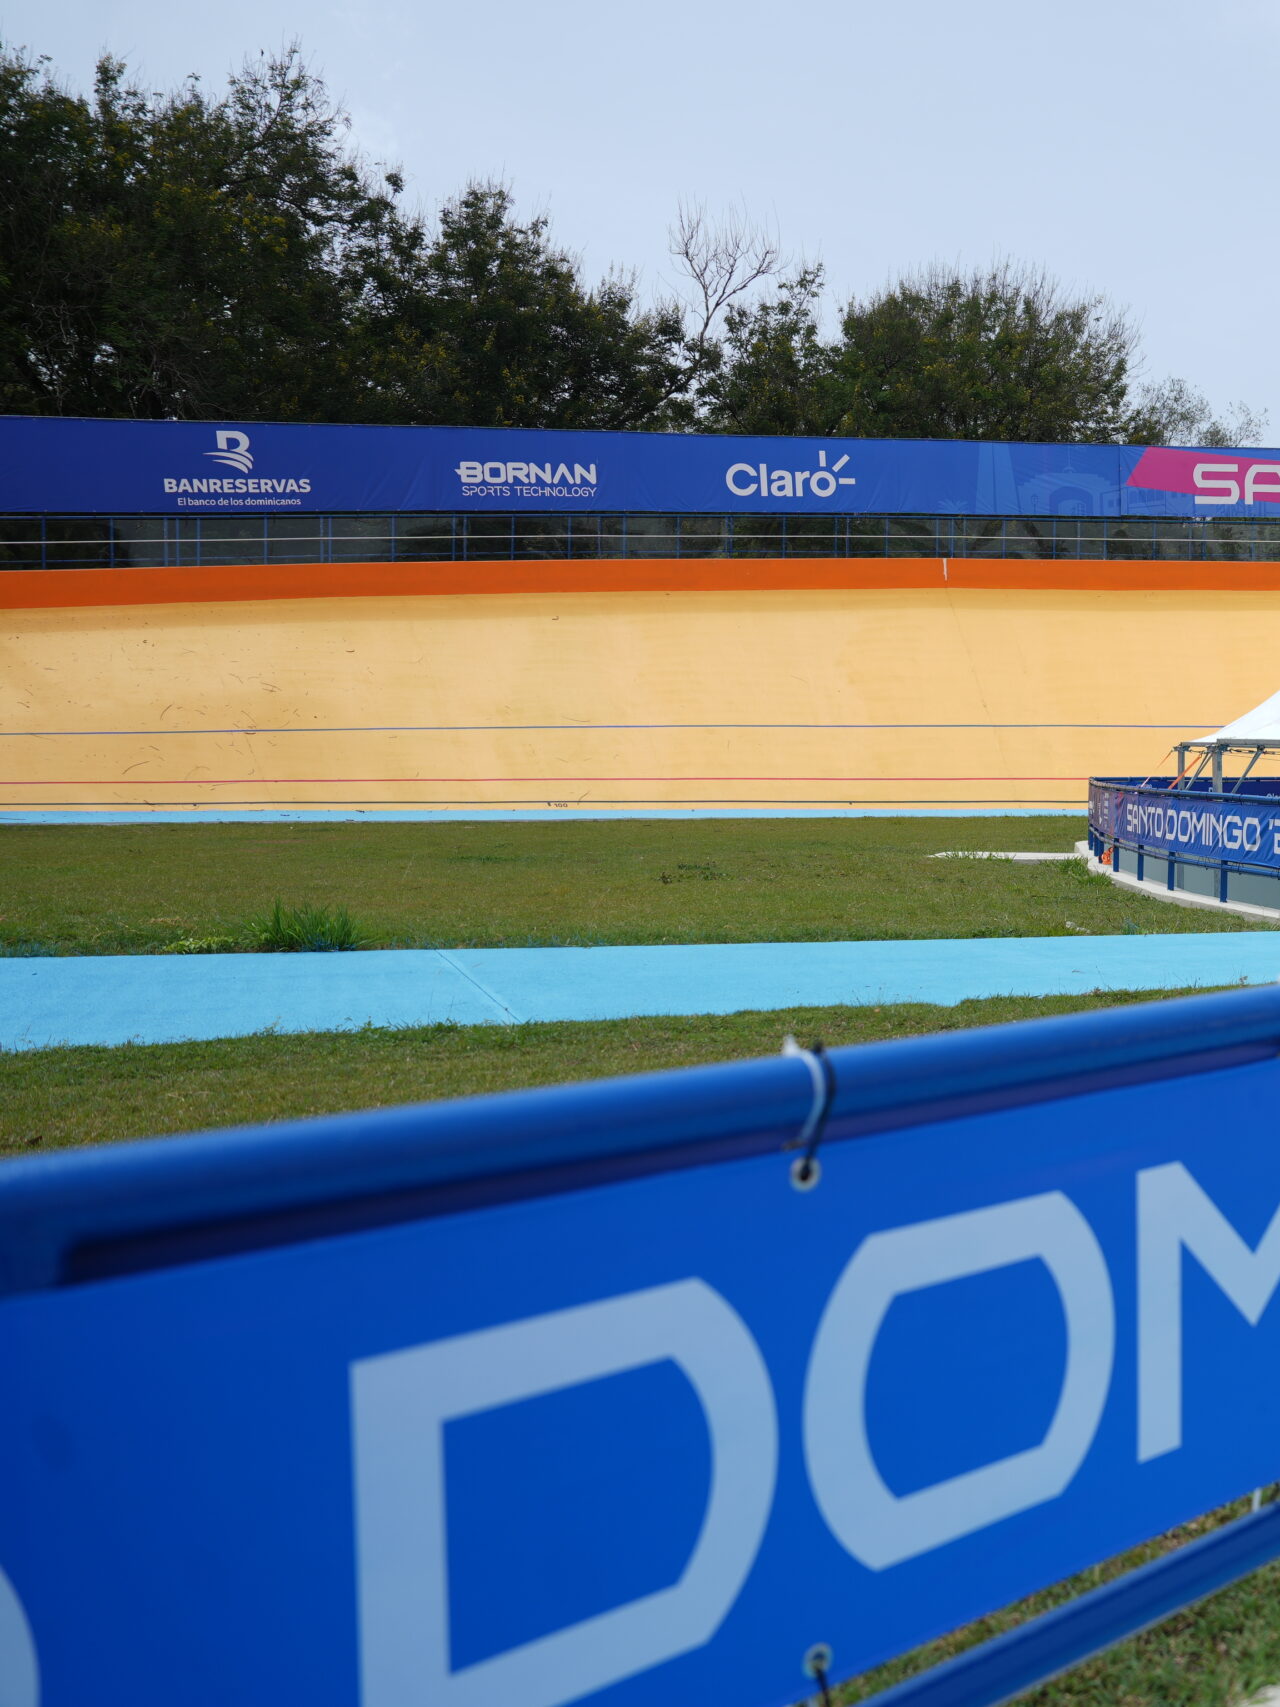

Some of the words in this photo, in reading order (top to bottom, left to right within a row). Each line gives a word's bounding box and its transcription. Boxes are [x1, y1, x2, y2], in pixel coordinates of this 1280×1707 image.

[455, 461, 597, 485] BORNAN
[726, 463, 837, 498] Claro
[163, 478, 312, 493] BANRESERVAS
[462, 486, 511, 497] SPORTS
[514, 486, 597, 497] TECHNOLOGY
[177, 497, 186, 506] El
[188, 497, 216, 506] banco
[217, 497, 229, 506] de
[230, 497, 244, 506] los
[245, 496, 302, 506] dominicanos
[1126, 803, 1163, 838] SANTO
[1165, 809, 1261, 852] DOMINGO
